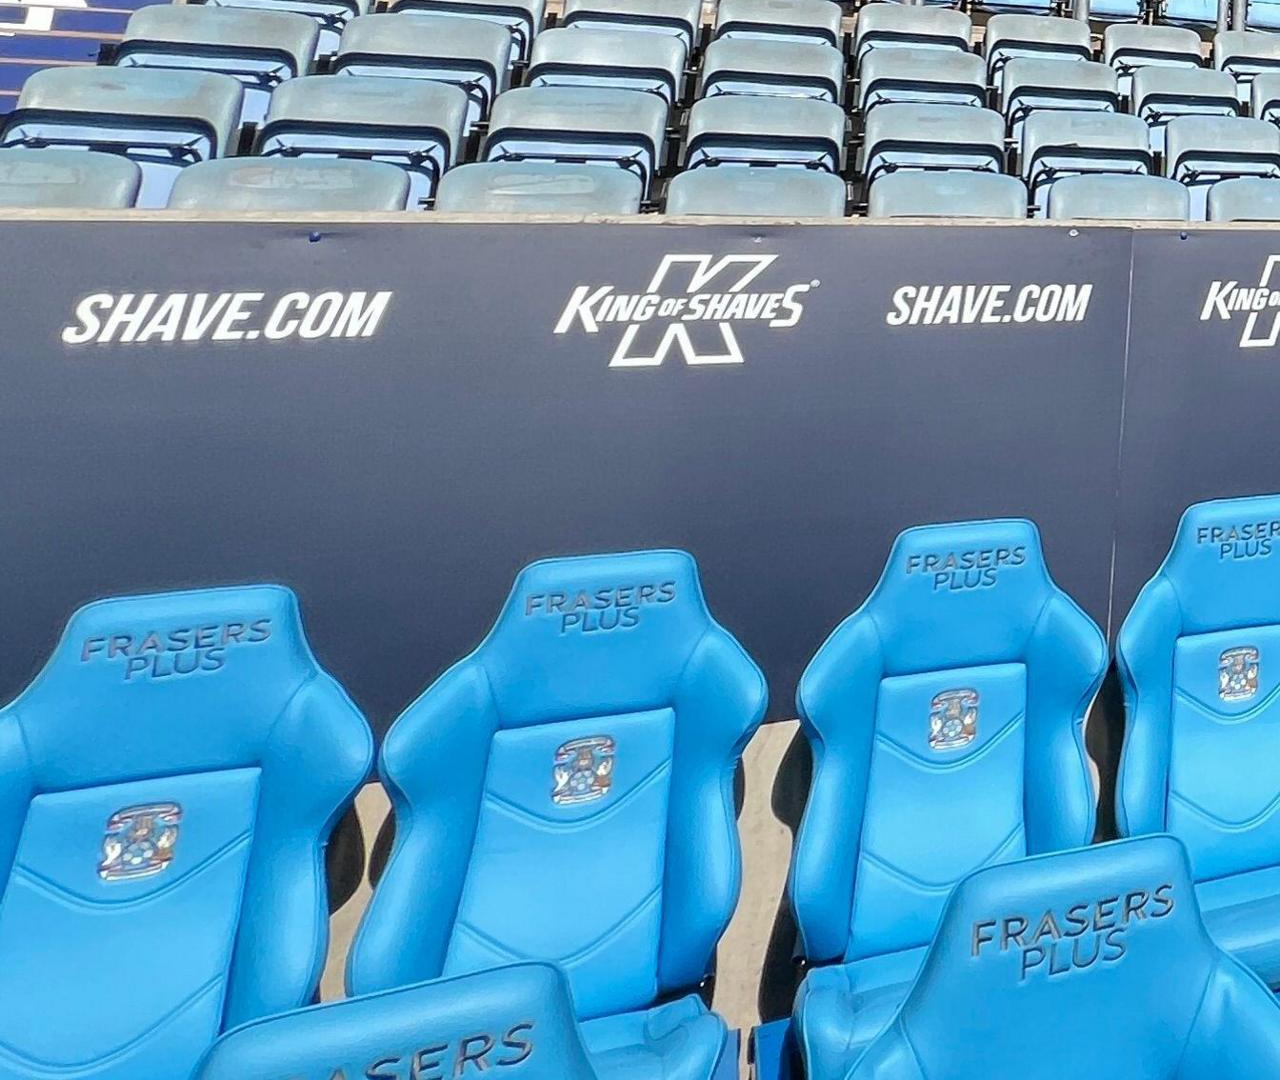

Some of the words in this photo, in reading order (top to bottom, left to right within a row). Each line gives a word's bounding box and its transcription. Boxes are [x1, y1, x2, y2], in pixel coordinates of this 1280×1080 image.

[62, 290, 392, 345] SHAVE.COM
[554, 286, 661, 333] KING
[683, 281, 809, 328] SHAVES
[885, 284, 1092, 327] SHAVE.COM
[1200, 281, 1270, 320] KING
[905, 545, 1026, 575] FRASERS
[1219, 536, 1273, 560] PLUS
[932, 566, 998, 591] PLUS
[525, 580, 678, 617] FRASERS
[561, 605, 640, 635] PLUS
[80, 618, 272, 663] FRASERS
[124, 647, 226, 681] PLUS
[971, 884, 1175, 957] FRASERS
[1019, 927, 1127, 982] PLUS
